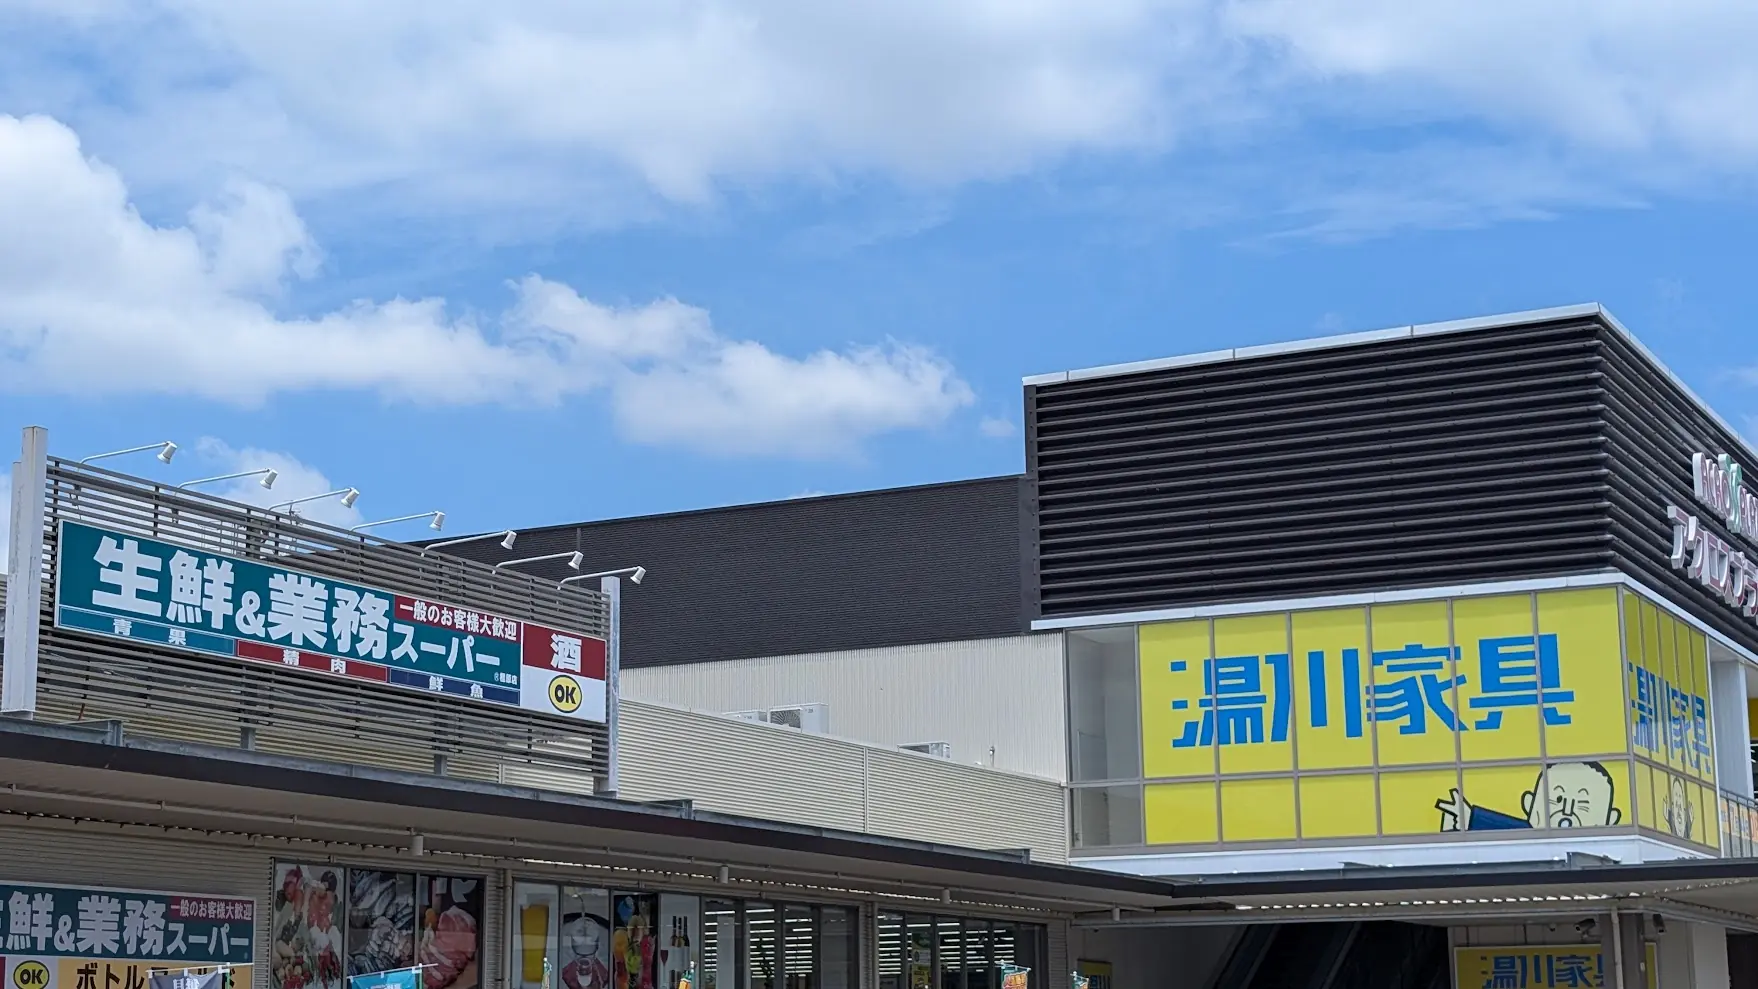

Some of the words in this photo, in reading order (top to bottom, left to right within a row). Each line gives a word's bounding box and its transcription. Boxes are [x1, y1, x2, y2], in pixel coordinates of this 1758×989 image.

[1667, 505, 1758, 622] アクロスプラ
[113, 617, 187, 646] 青果
[399, 600, 517, 641] 一般のお客様大歓迎
[550, 633, 582, 673] 酒
[429, 675, 484, 698] 鮮魚
[554, 684, 577, 705] OK
[1170, 632, 1575, 748] 湯川家具
[1628, 662, 1711, 774] 湯川家具
[0, 890, 249, 956] 鮮&業務スーパー
[170, 899, 253, 921] 一般のお客様大歓迎
[19, 966, 44, 985] OK
[1480, 954, 1604, 989] 湯川家
